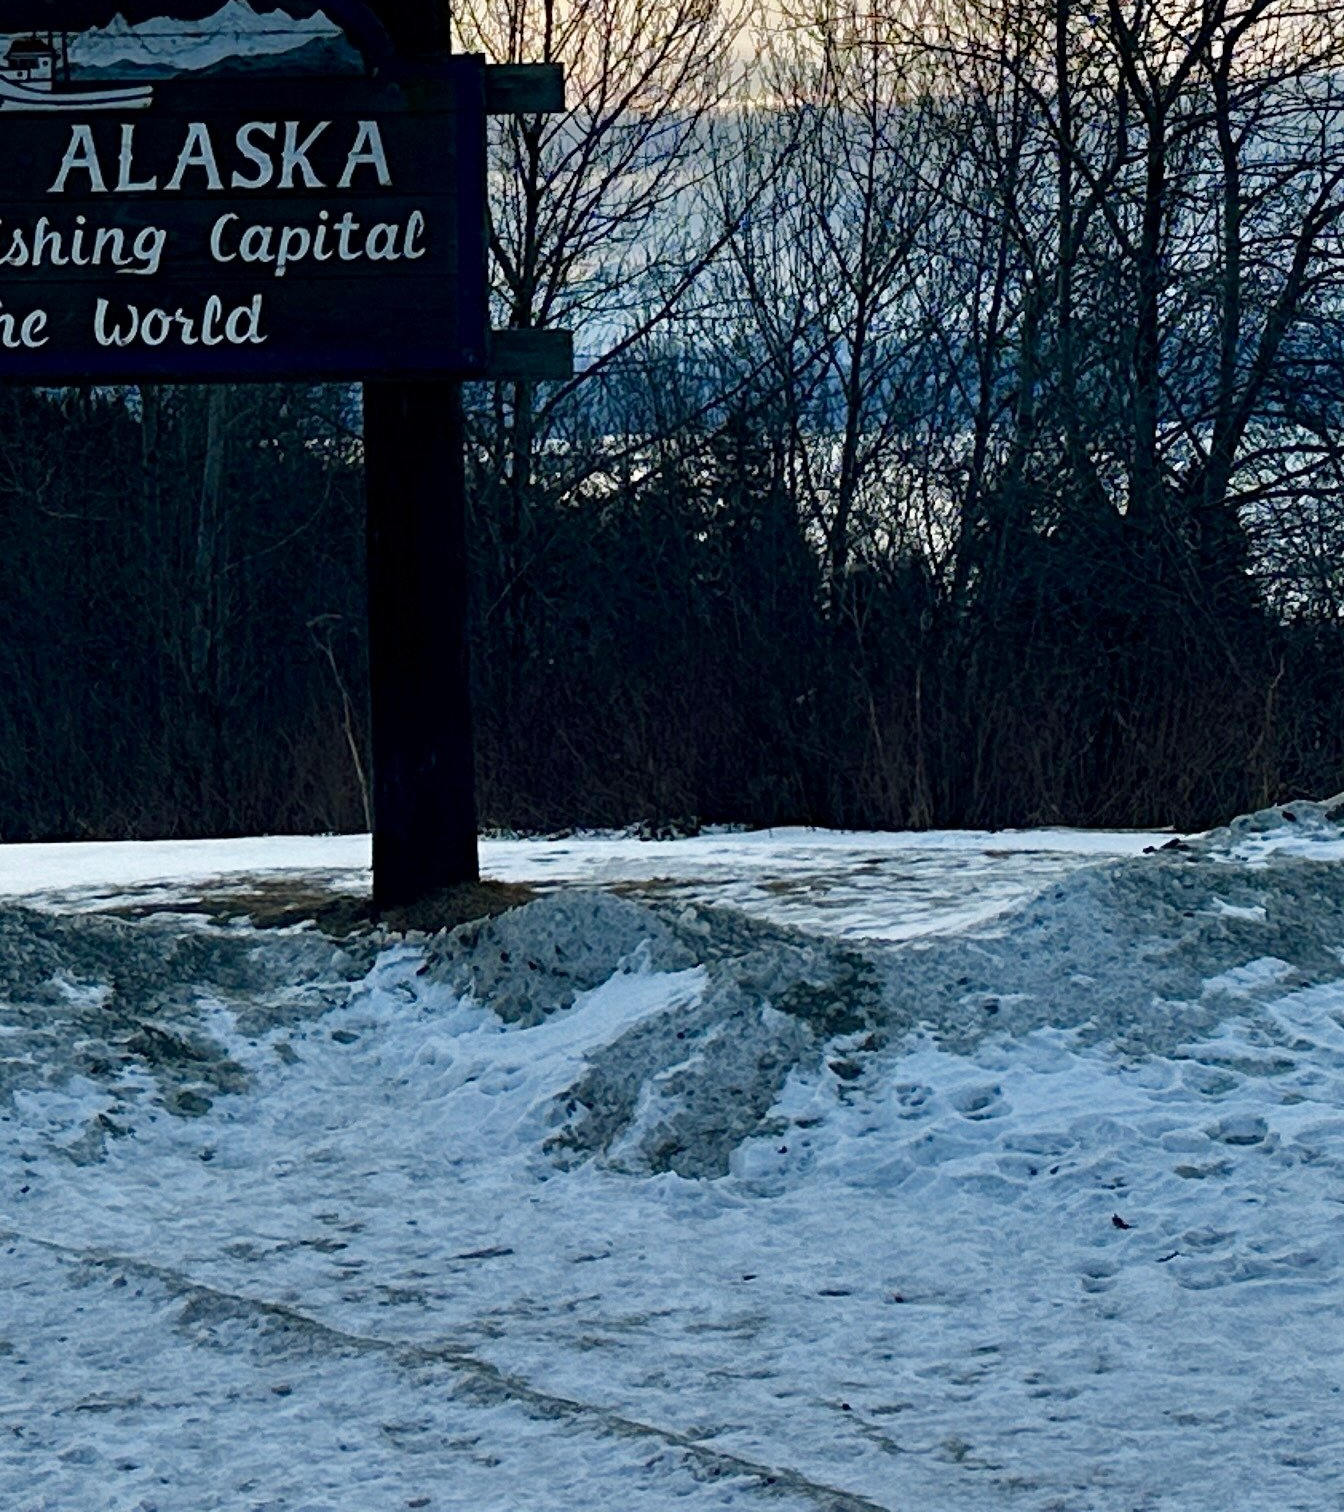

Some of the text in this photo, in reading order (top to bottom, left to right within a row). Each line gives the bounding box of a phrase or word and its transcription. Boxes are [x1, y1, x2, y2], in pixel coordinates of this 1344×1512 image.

[46, 119, 391, 194] ALASKA
[209, 209, 427, 278] Capital
[93, 292, 269, 348] World
